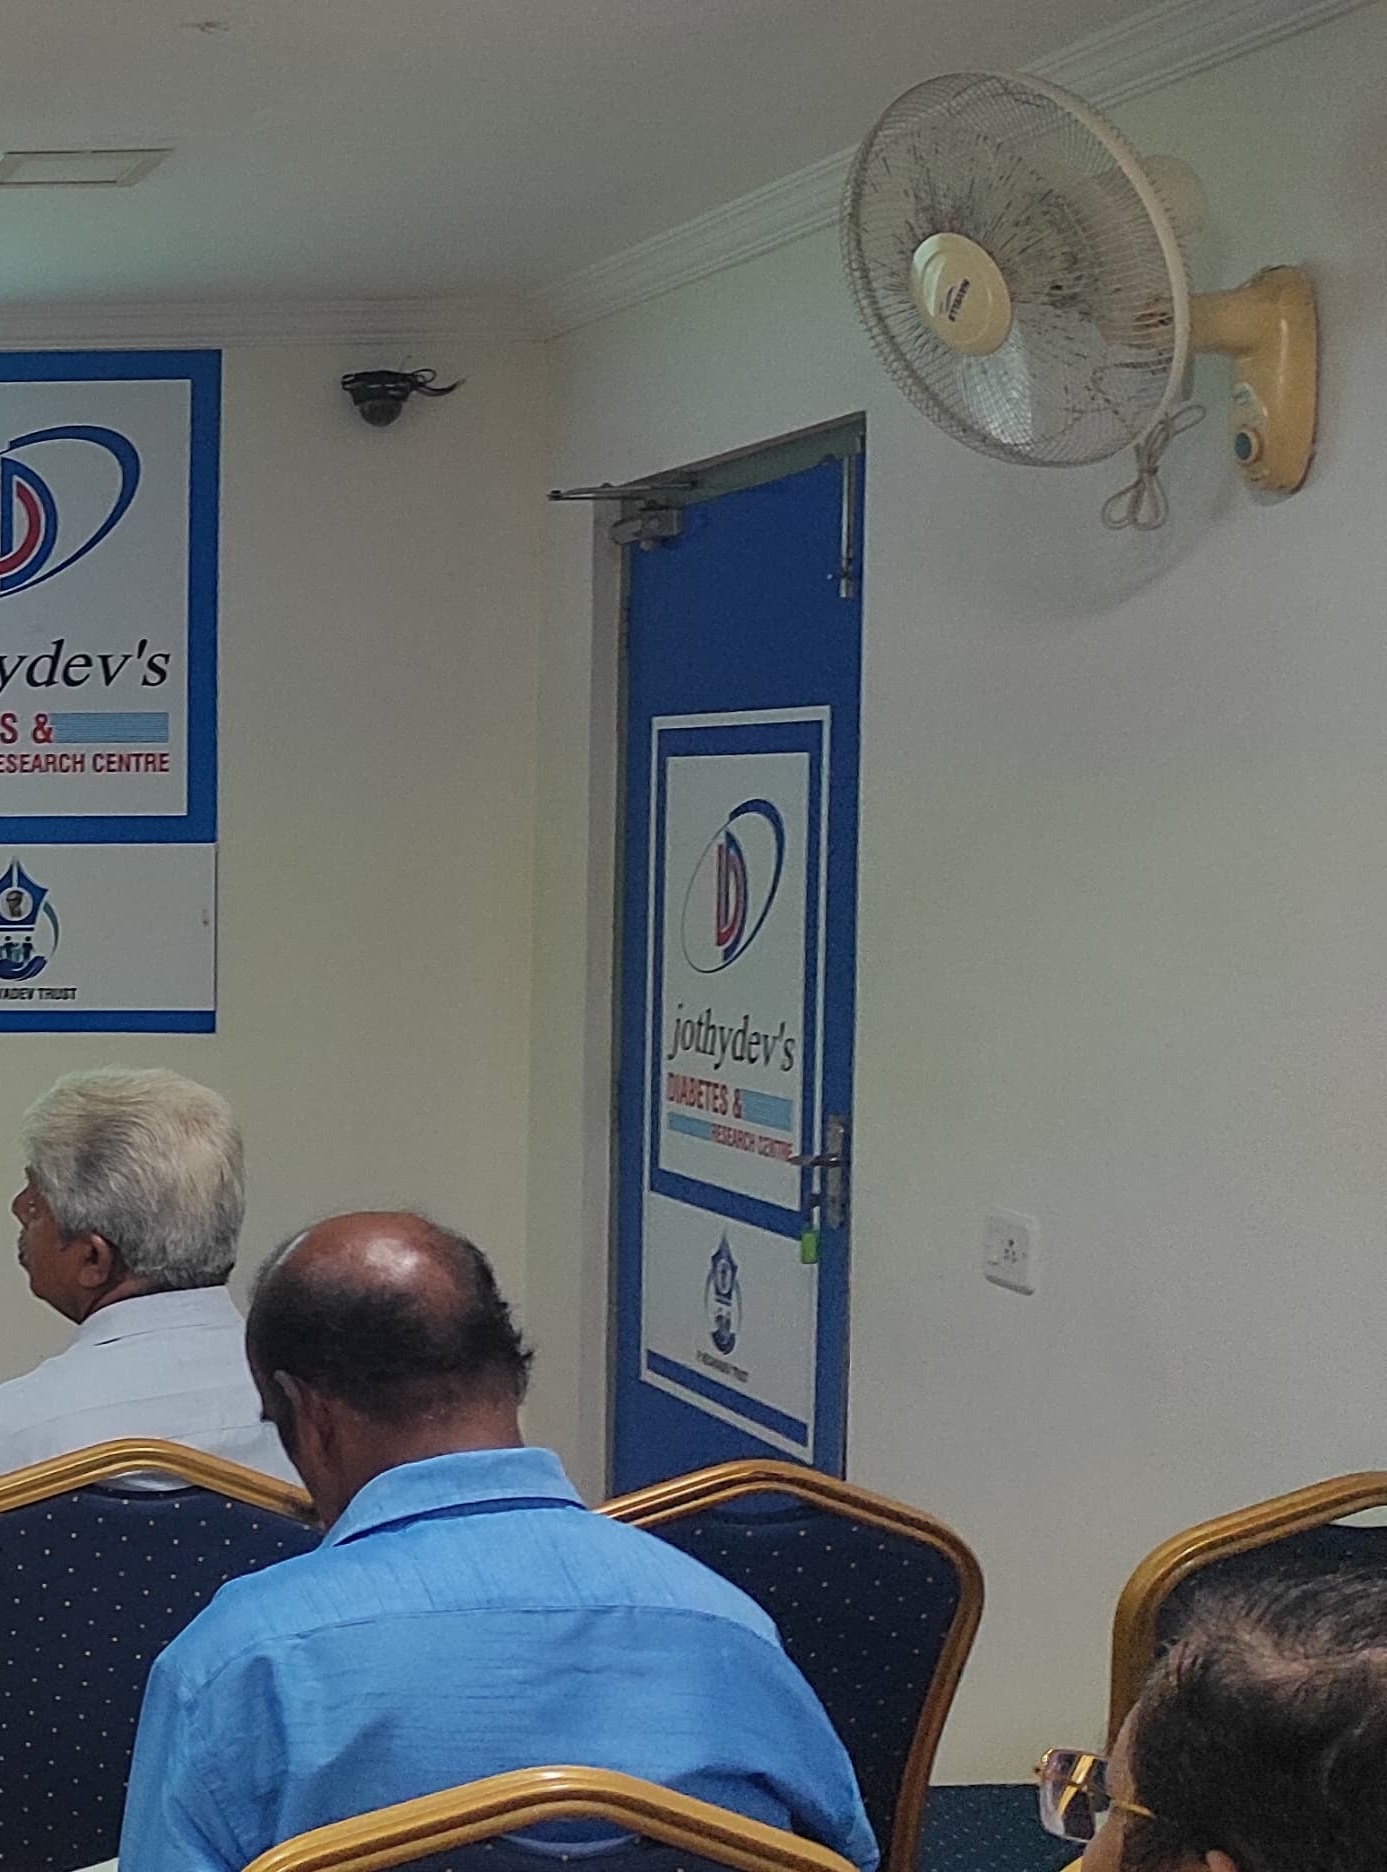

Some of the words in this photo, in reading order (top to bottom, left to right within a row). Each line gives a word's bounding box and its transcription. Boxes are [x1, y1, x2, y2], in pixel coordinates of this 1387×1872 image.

[31, 712, 54, 745] &
[92, 752, 171, 773] CENTRE
[667, 1003, 796, 1072] jothydev's
[667, 1072, 729, 1116] DIABETES
